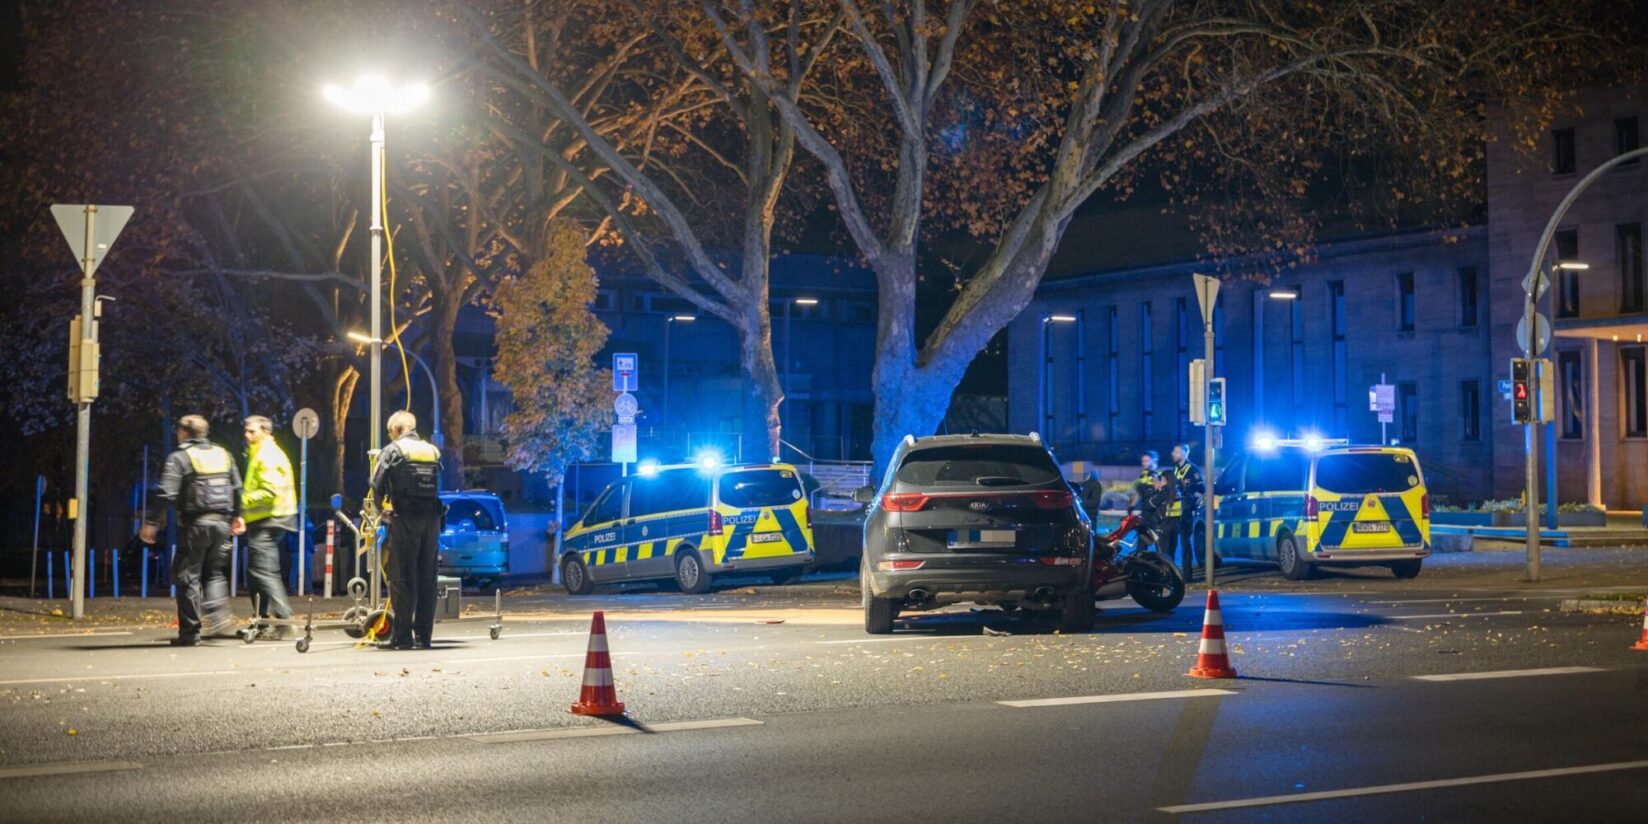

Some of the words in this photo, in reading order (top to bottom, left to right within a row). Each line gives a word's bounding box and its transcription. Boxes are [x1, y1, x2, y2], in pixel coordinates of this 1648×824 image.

[1319, 502, 1359, 511] POLIZEI
[722, 515, 756, 525] POLIZEI
[594, 532, 616, 544] POLIZEI
